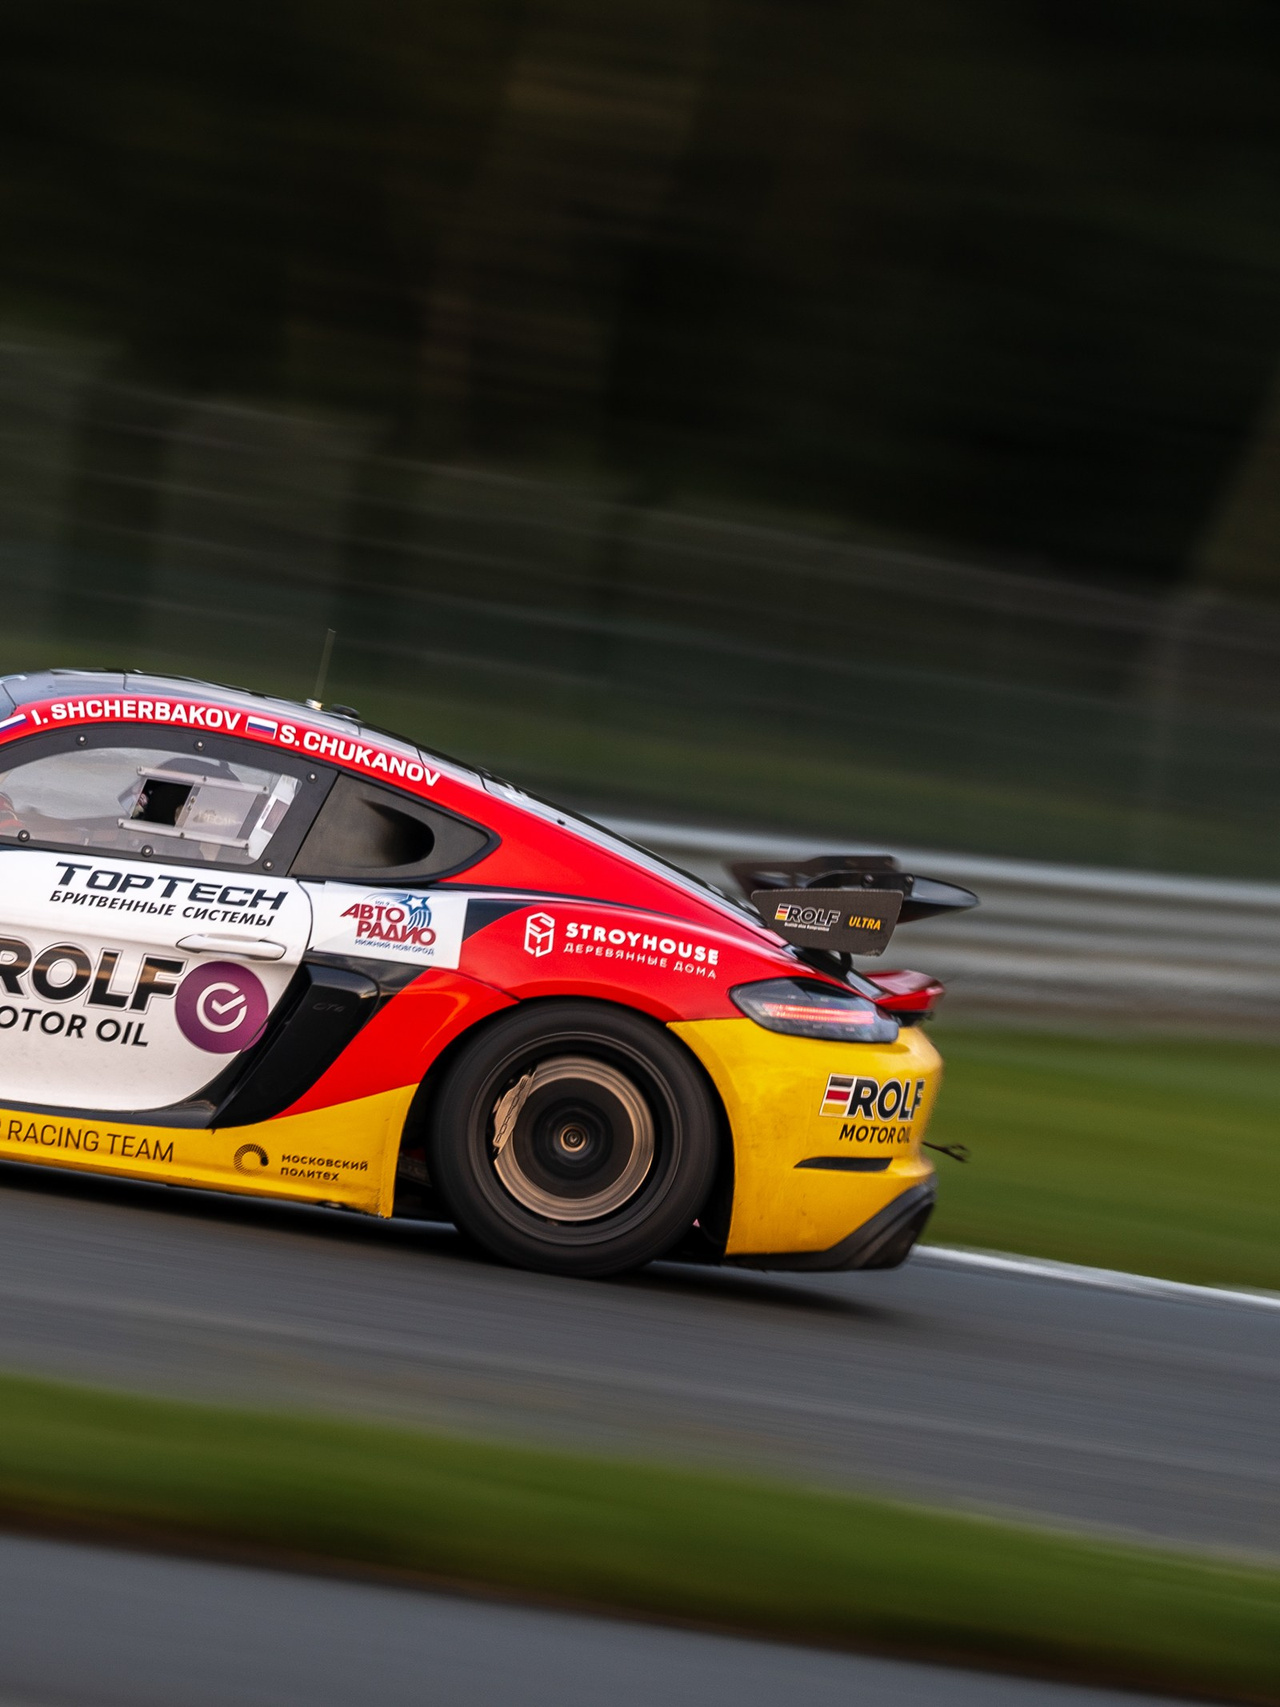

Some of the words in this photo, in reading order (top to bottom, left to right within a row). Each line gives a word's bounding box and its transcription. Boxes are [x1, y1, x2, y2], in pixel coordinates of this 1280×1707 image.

[30, 709, 49, 726] I.
[51, 699, 241, 730] SHCHERBAKOV
[279, 724, 300, 747] S.
[303, 731, 441, 787] CHUKANOV
[49, 890, 176, 916] БРИТВЕННЫЕ
[182, 906, 275, 927] СИСТЕМЫ
[340, 903, 405, 924] АВТО
[786, 903, 841, 927] ROLF
[848, 915, 881, 931] ULTRA
[356, 920, 436, 946] РАДИО
[566, 923, 719, 966] STROYHOUSE
[563, 942, 668, 968] ДЕРЕВЯННЫЕ
[673, 961, 717, 980] ДОМА
[96, 1018, 149, 1047] OIL
[847, 1077, 925, 1122] ROLF
[7, 1120, 99, 1152] RACING
[106, 1133, 174, 1163] TEAM
[839, 1124, 896, 1144] MOTOR
